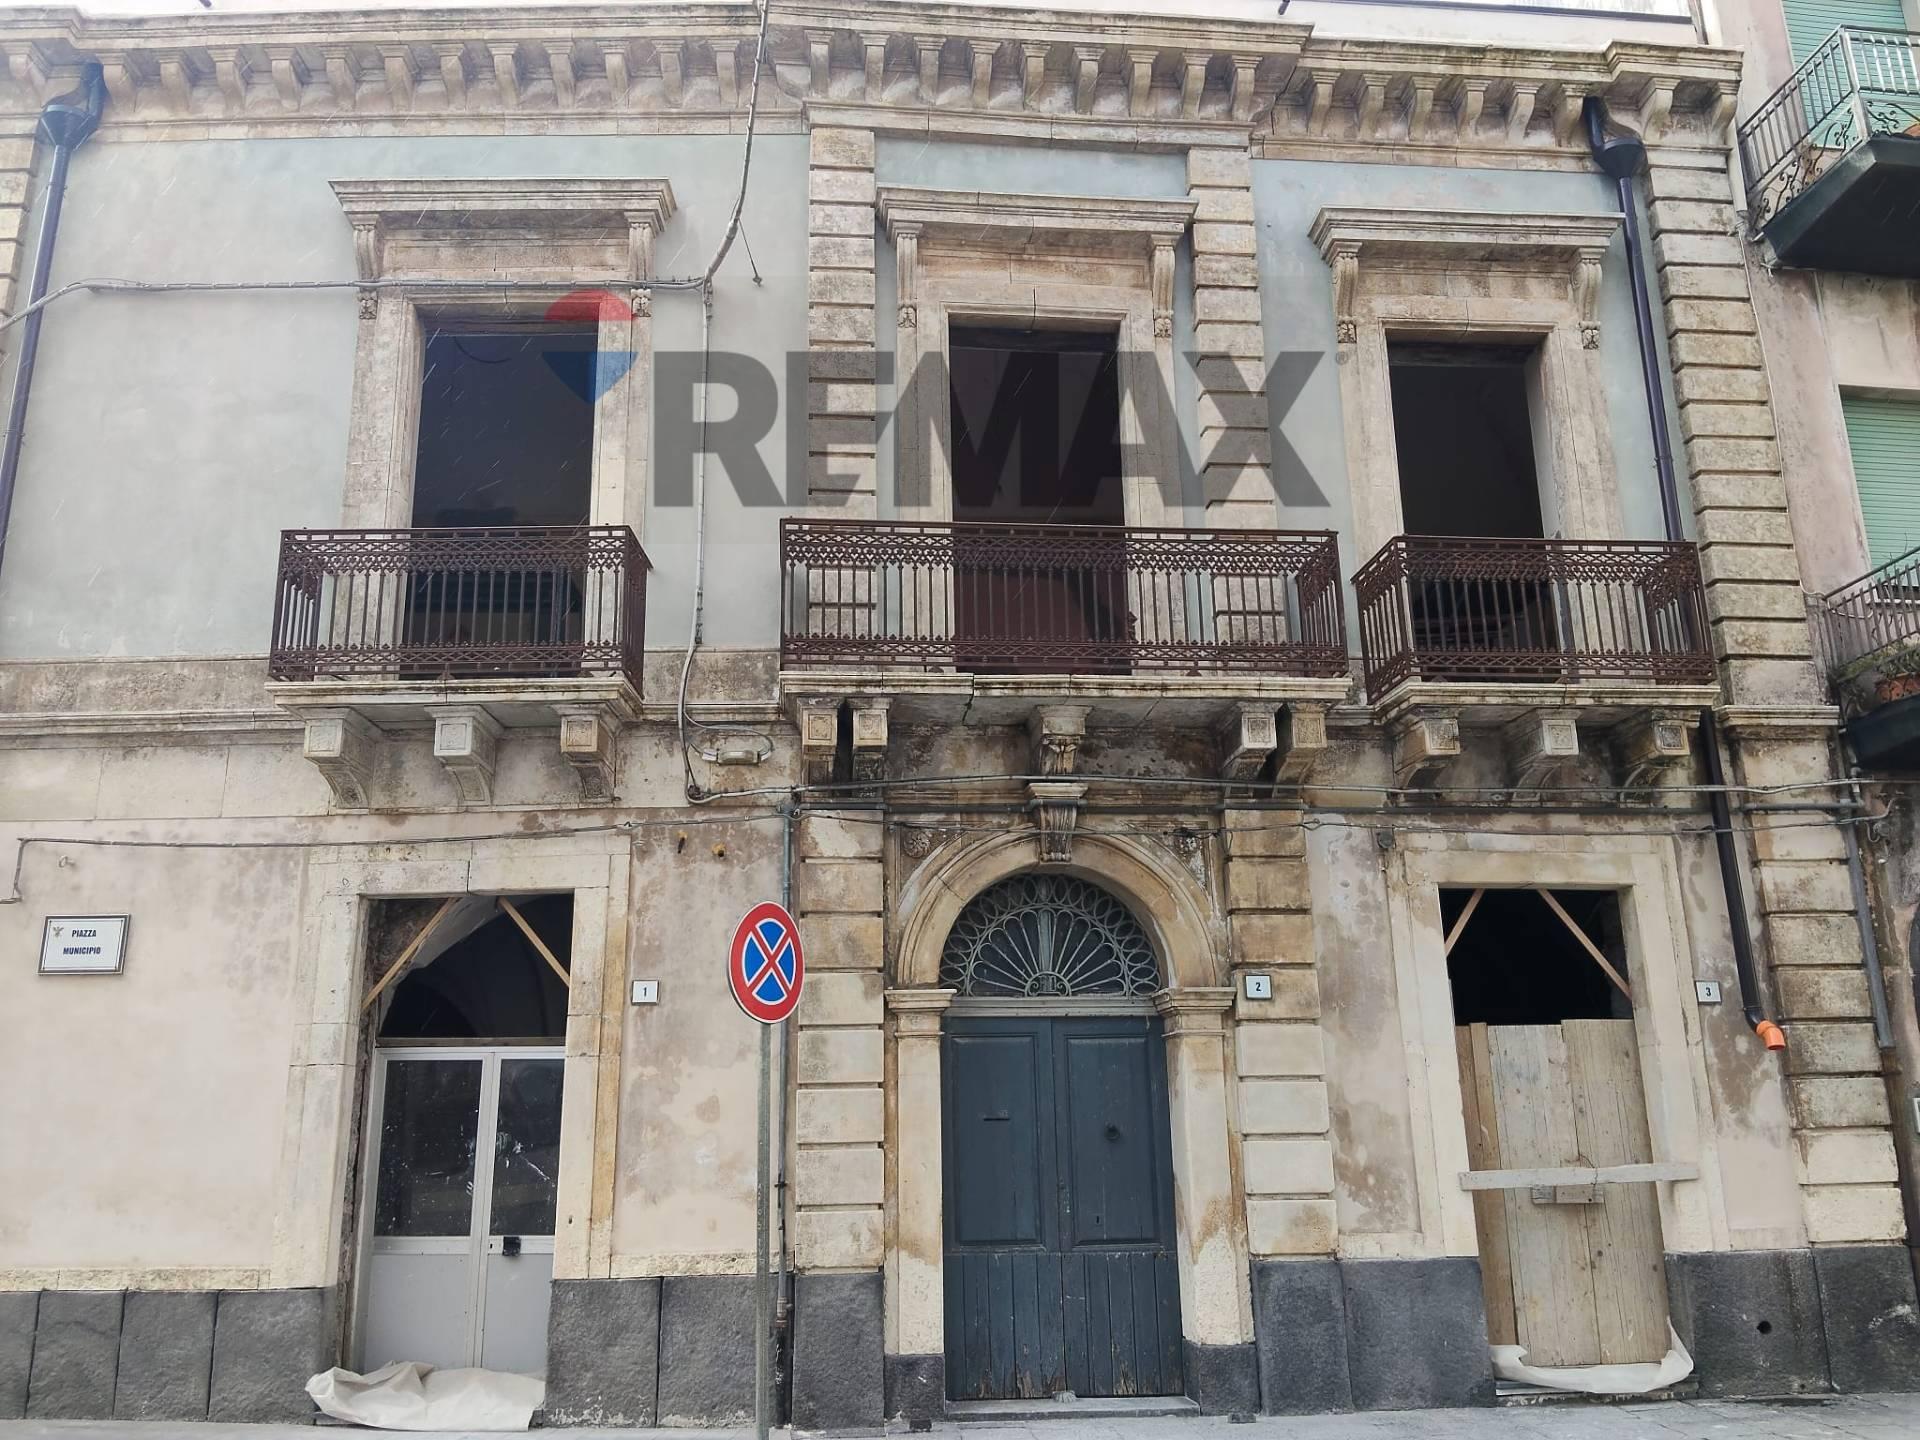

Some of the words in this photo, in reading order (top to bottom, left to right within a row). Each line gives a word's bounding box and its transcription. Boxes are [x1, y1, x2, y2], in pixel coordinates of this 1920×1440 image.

[71, 929, 97, 938] PIAZZA
[62, 946, 101, 955] MUNICIPIO
[1255, 982, 1262, 992] 2
[1705, 987, 1712, 997] 3
